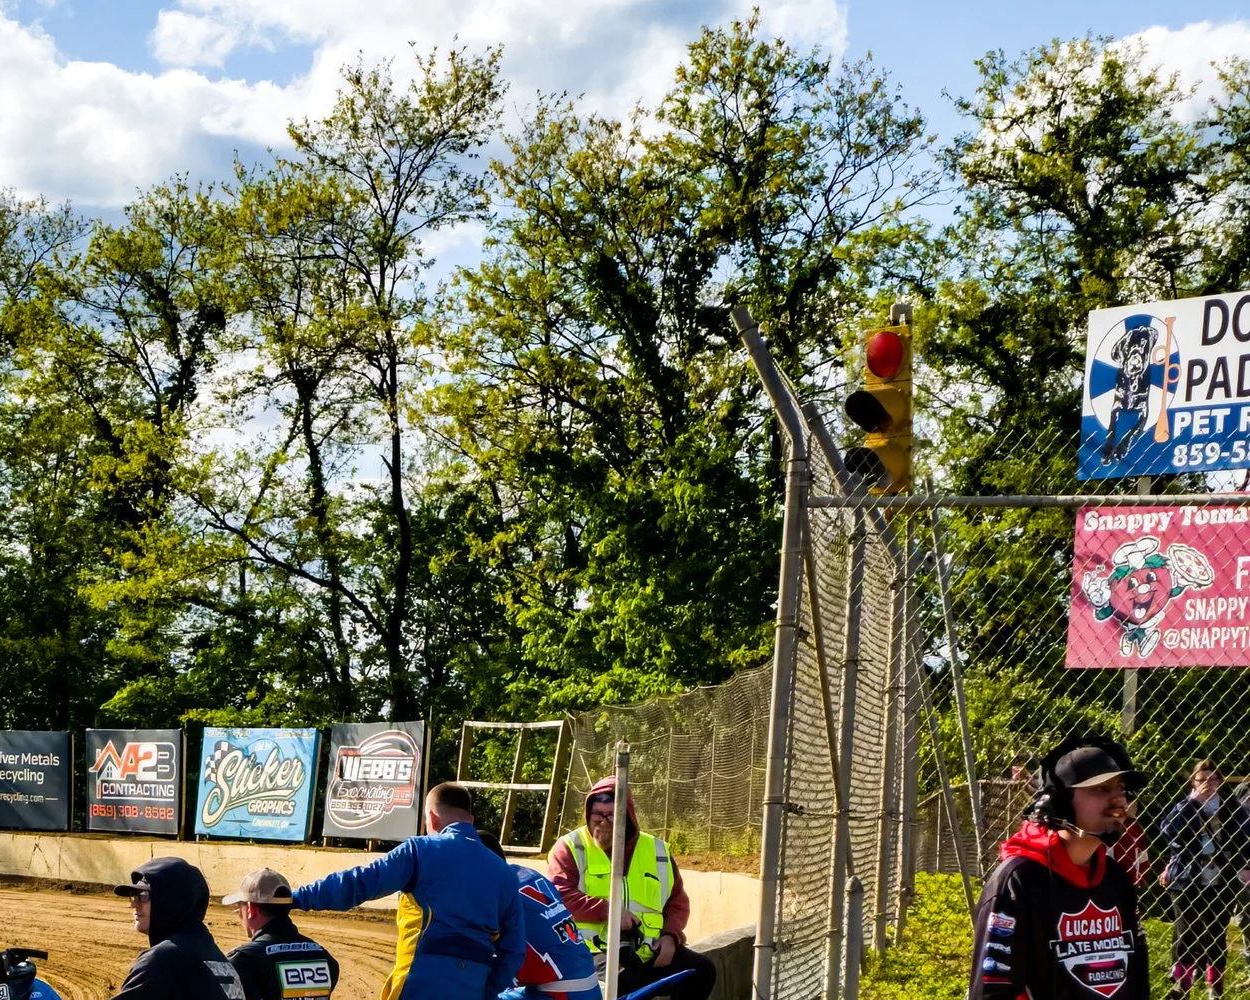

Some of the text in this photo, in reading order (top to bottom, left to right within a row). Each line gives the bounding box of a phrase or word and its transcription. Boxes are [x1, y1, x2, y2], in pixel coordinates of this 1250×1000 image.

[1173, 407, 1231, 436] PET
[1173, 440, 1250, 467] 859-5
[1083, 505, 1250, 534] Snappy Toma
[1185, 597, 1249, 621] SNAPPY
[1163, 626, 1250, 650] @SNAPPYT
[21, 752, 60, 766] Metals
[120, 742, 177, 782] A2B
[341, 755, 414, 781] WEBB'S
[102, 782, 175, 797] CONTRACTING
[89, 804, 117, 820] (859)
[248, 800, 296, 816] GRAPHICS
[1066, 915, 1120, 937] LUCAS OIL
[1055, 941, 1092, 958] LATE
[284, 967, 329, 985] BRS
